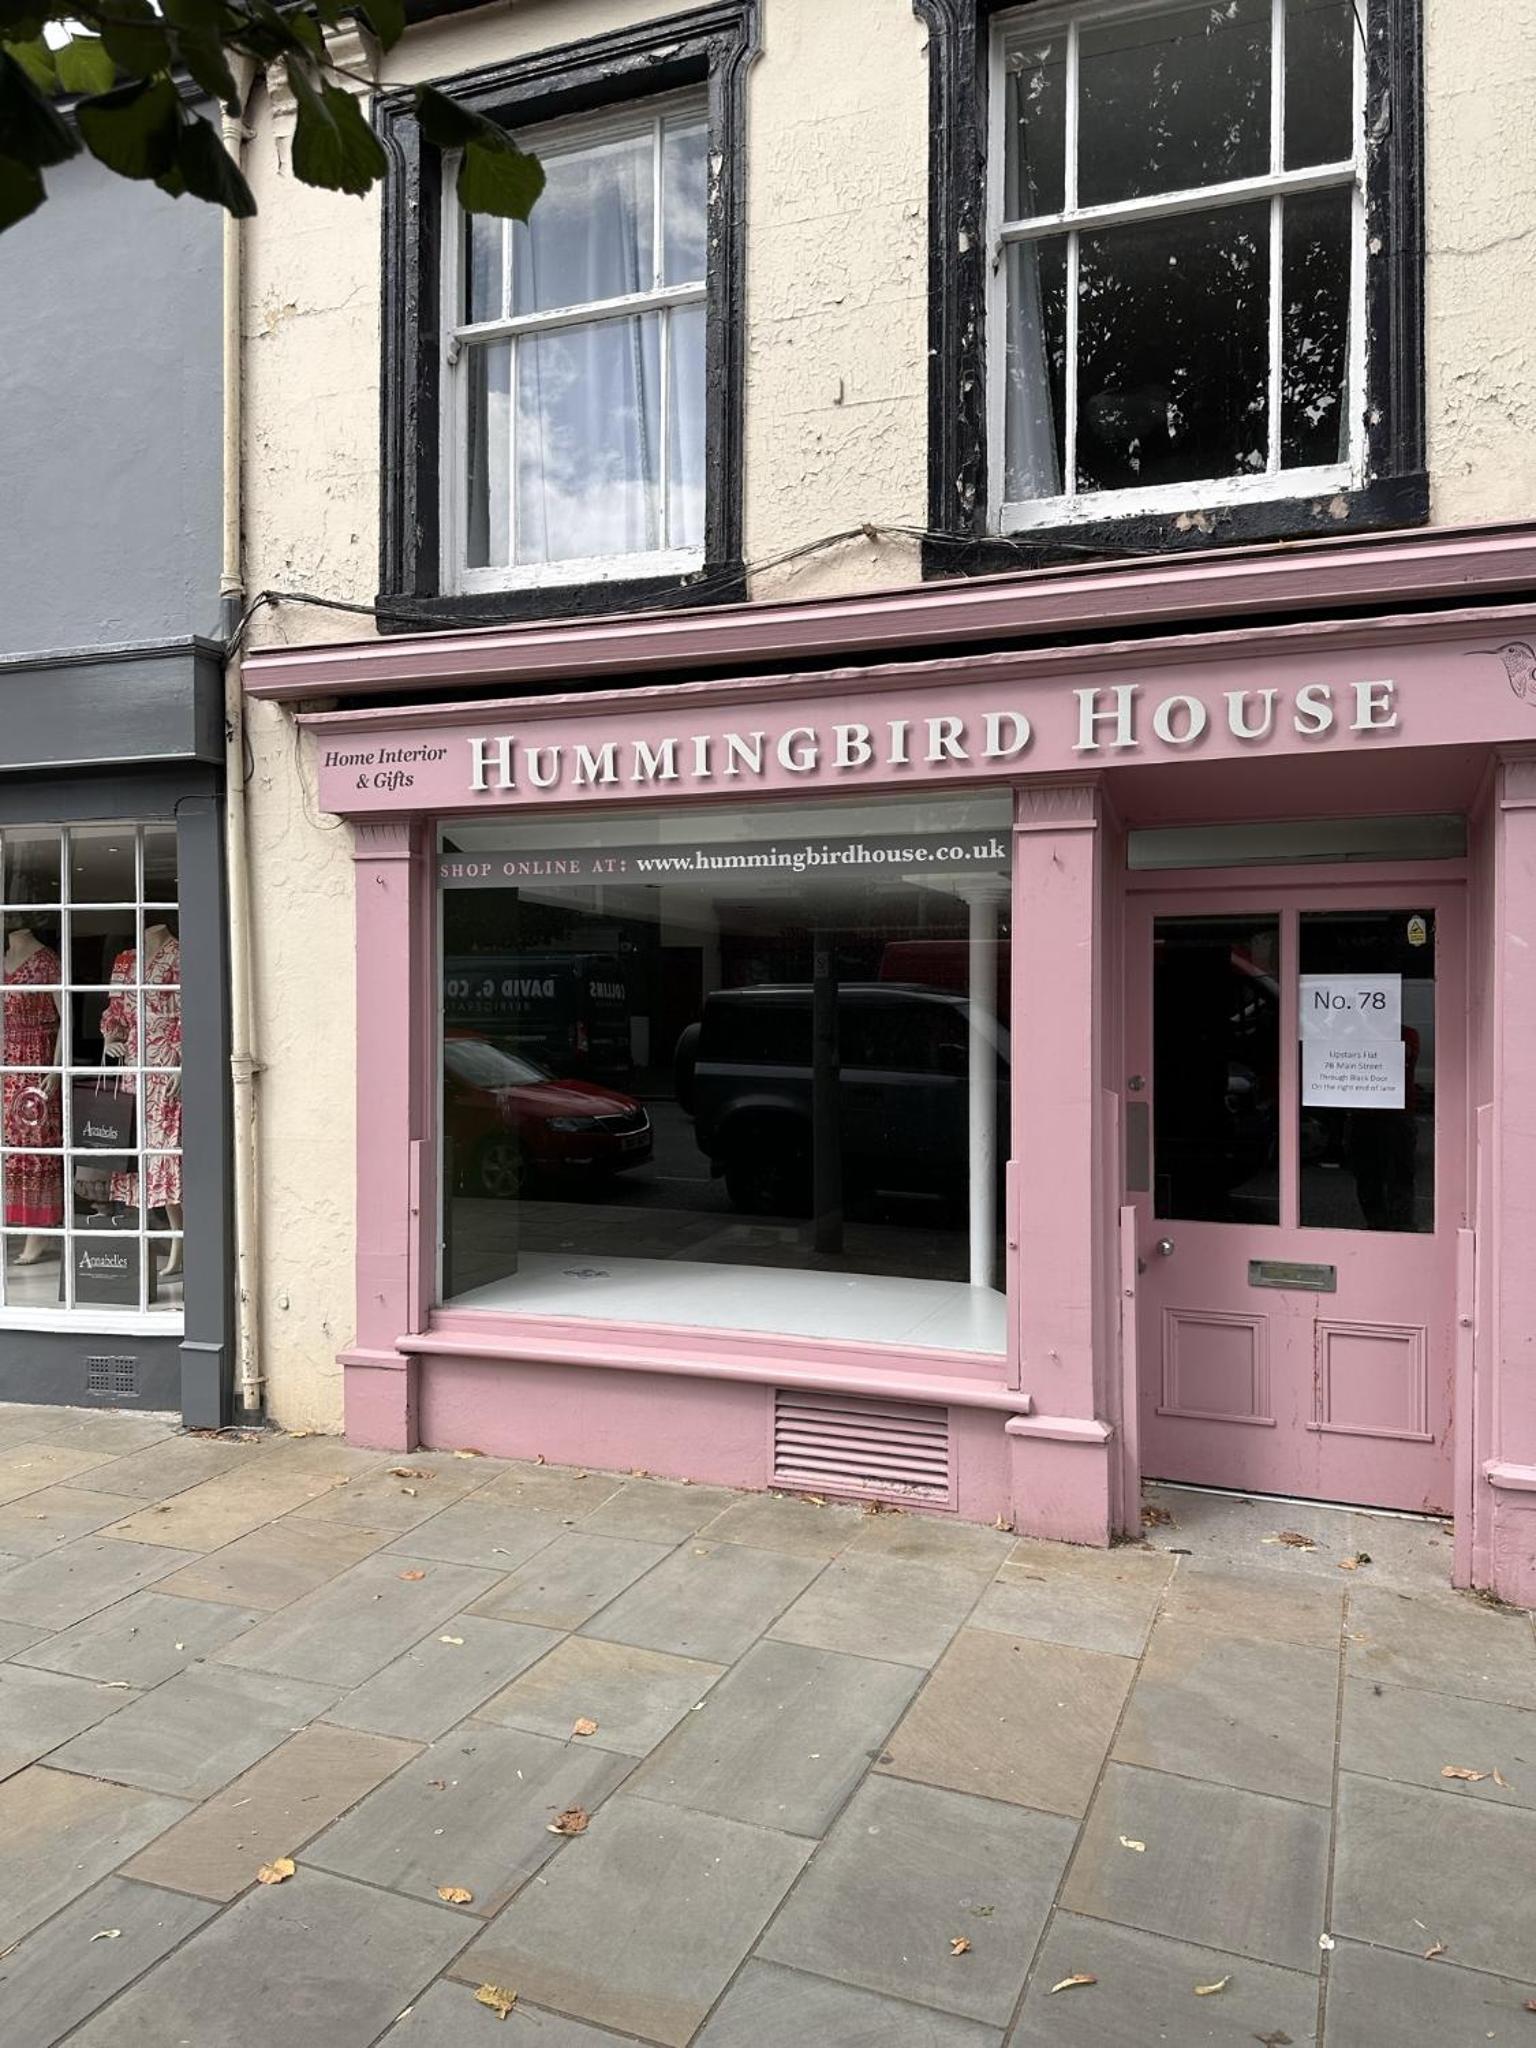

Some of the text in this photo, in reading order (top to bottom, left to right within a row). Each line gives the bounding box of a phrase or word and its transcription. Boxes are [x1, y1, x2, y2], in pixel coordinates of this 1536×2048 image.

[466, 679, 1399, 791] HUMMINGBIRD HOUSE
[324, 744, 448, 768] Home Interior
[355, 769, 415, 792] & Gifts
[439, 838, 1006, 878] SHOP ONLINE AT: www.hummingbirdhouse.co.uk
[1314, 991, 1387, 1010] No. 78
[1329, 1050, 1361, 1060] Upstairs
[1336, 1061, 1357, 1070] Main
[1358, 1061, 1383, 1070] Street
